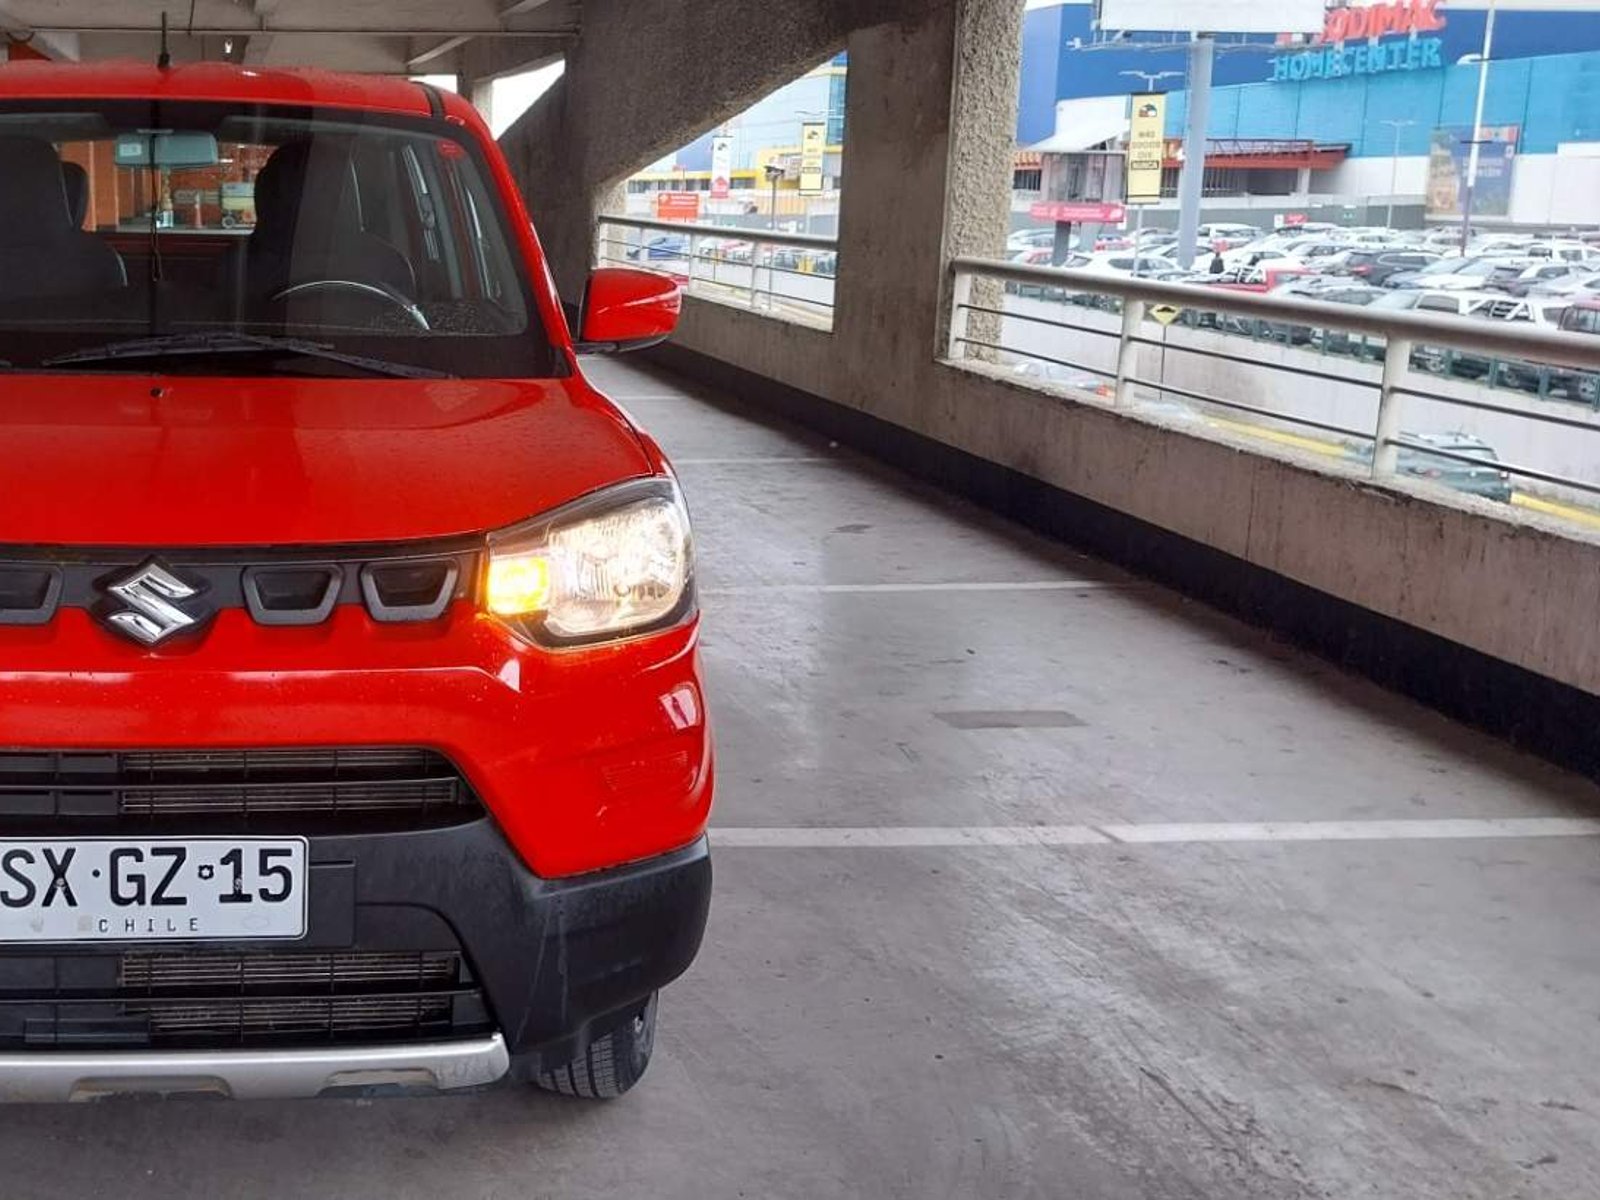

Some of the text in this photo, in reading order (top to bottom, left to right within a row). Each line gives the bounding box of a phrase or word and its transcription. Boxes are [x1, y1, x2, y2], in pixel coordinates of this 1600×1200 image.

[1316, 0, 1446, 44] ODIMAC
[1267, 37, 1442, 81] HOMECENTER
[98, 917, 198, 932] CHILE
